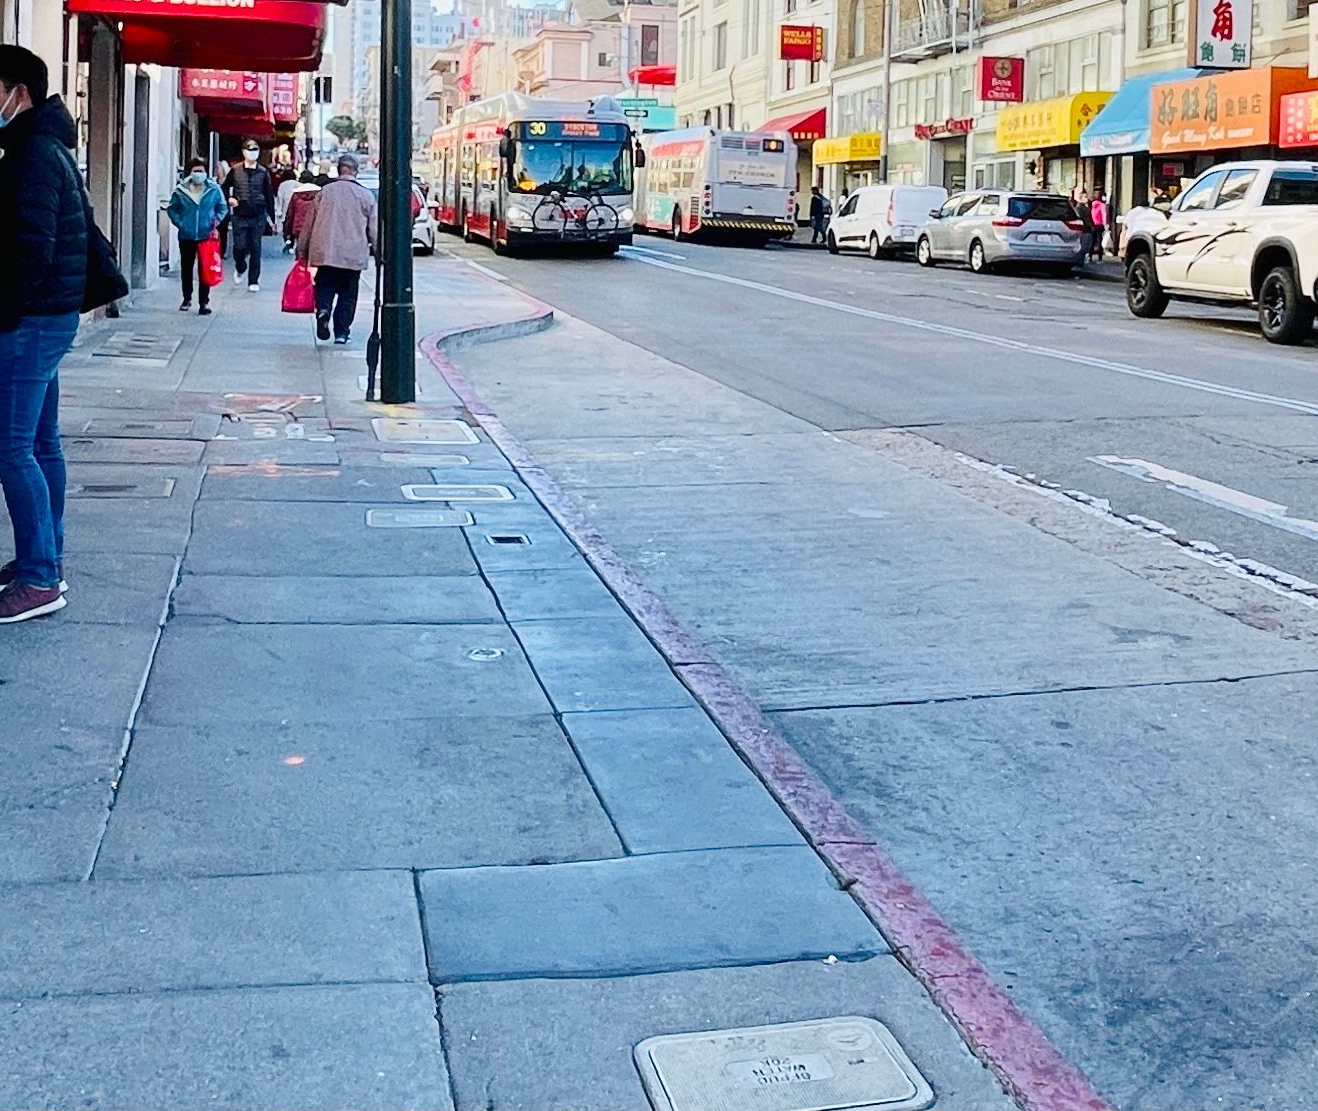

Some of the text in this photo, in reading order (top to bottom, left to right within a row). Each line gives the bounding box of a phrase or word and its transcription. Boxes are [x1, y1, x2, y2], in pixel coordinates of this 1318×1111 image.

[783, 30, 811, 38] WELLS
[784, 37, 811, 45] FARGO
[991, 78, 1012, 87] BANK
[988, 90, 1015, 99] ORIENT
[1157, 80, 1218, 126] 好旺角
[530, 122, 546, 135] 30
